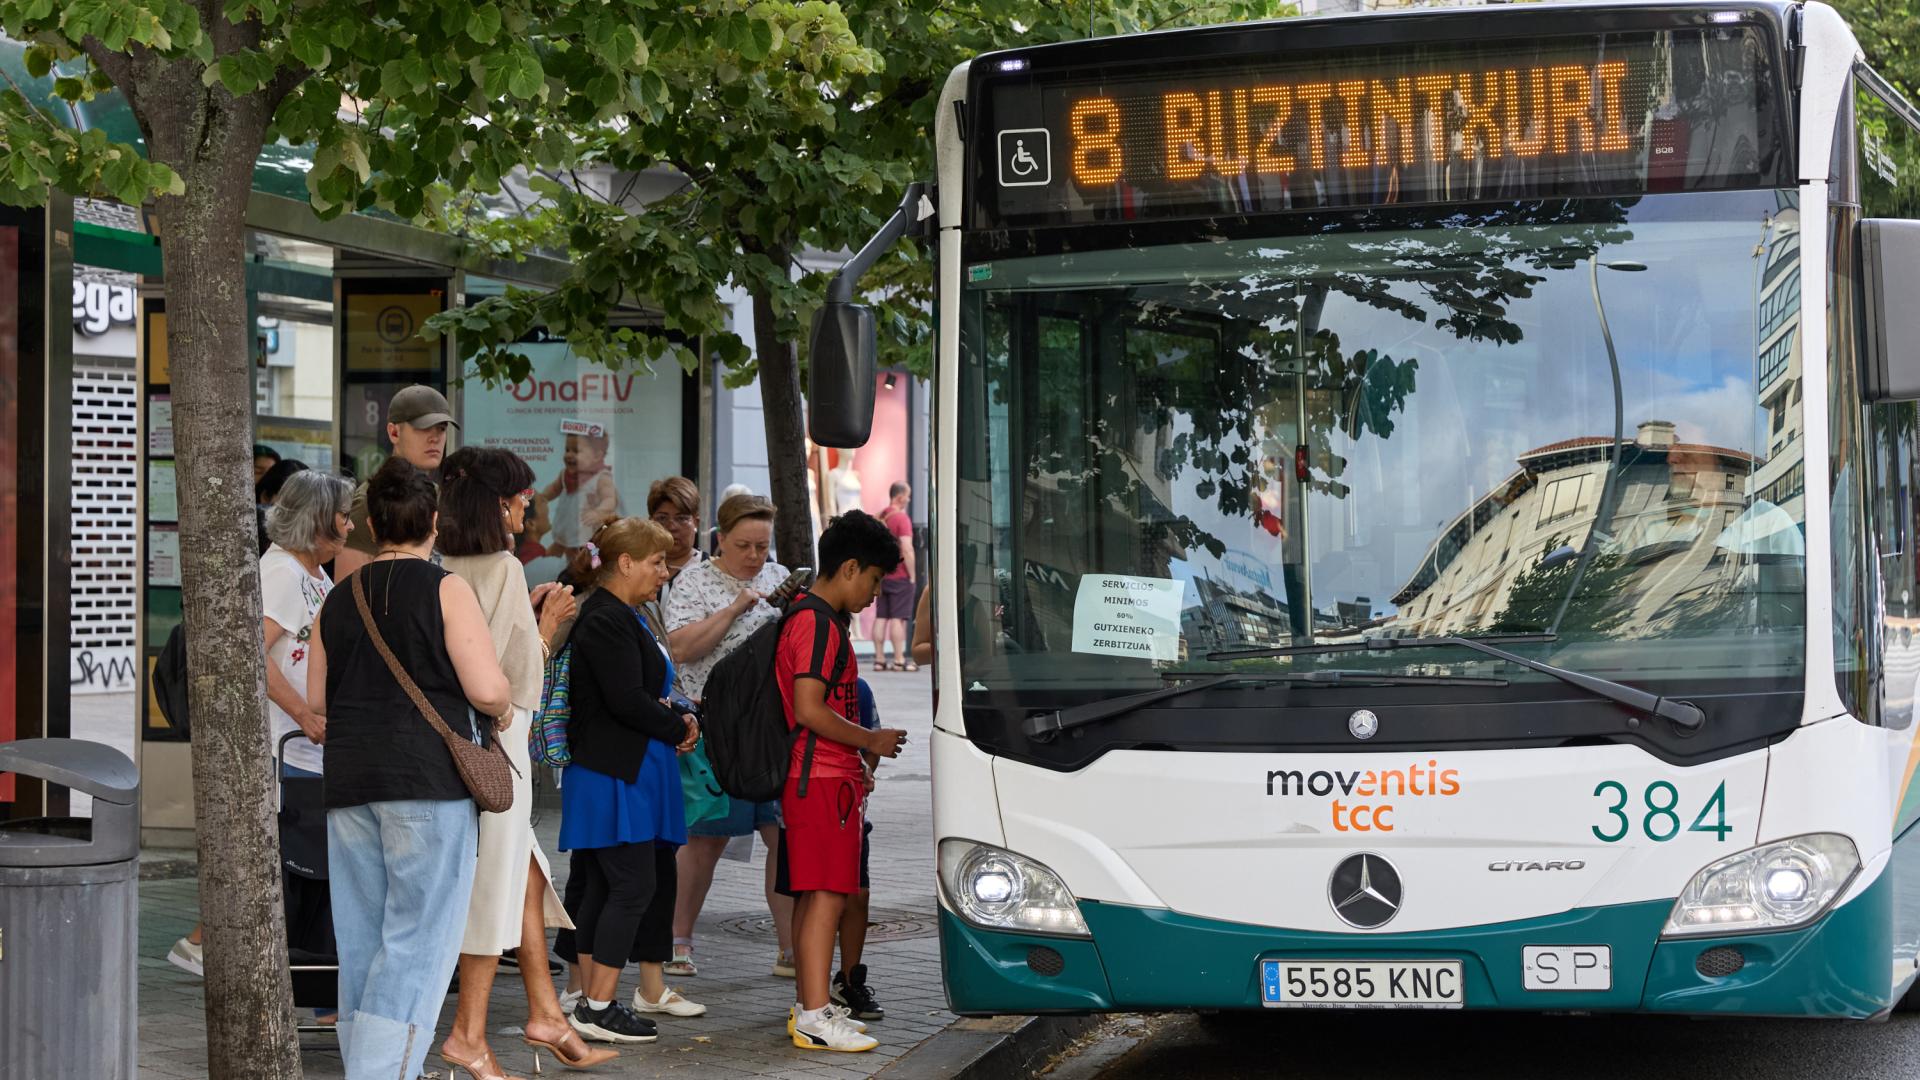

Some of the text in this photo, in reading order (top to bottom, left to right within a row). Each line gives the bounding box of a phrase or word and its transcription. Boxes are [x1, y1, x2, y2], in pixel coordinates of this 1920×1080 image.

[1071, 61, 1630, 184] 8 BUZTINTXURI
[73, 280, 137, 333] ega
[506, 374, 634, 402] OnaFIV
[365, 402, 380, 425] 8
[1102, 580, 1154, 591] SERVICIOS
[1104, 596, 1149, 607] MINIMOS
[1094, 623, 1155, 636] GUTXIENEKO
[1093, 639, 1152, 652] ZERBITZUAK
[834, 682, 859, 700] CH
[1266, 759, 1461, 796] moventis
[1332, 799, 1394, 832] tcc
[1591, 779, 1732, 843] 384
[1488, 859, 1586, 872] CITARO
[1269, 986, 1276, 995] E
[1286, 967, 1455, 998] 5585 KNC
